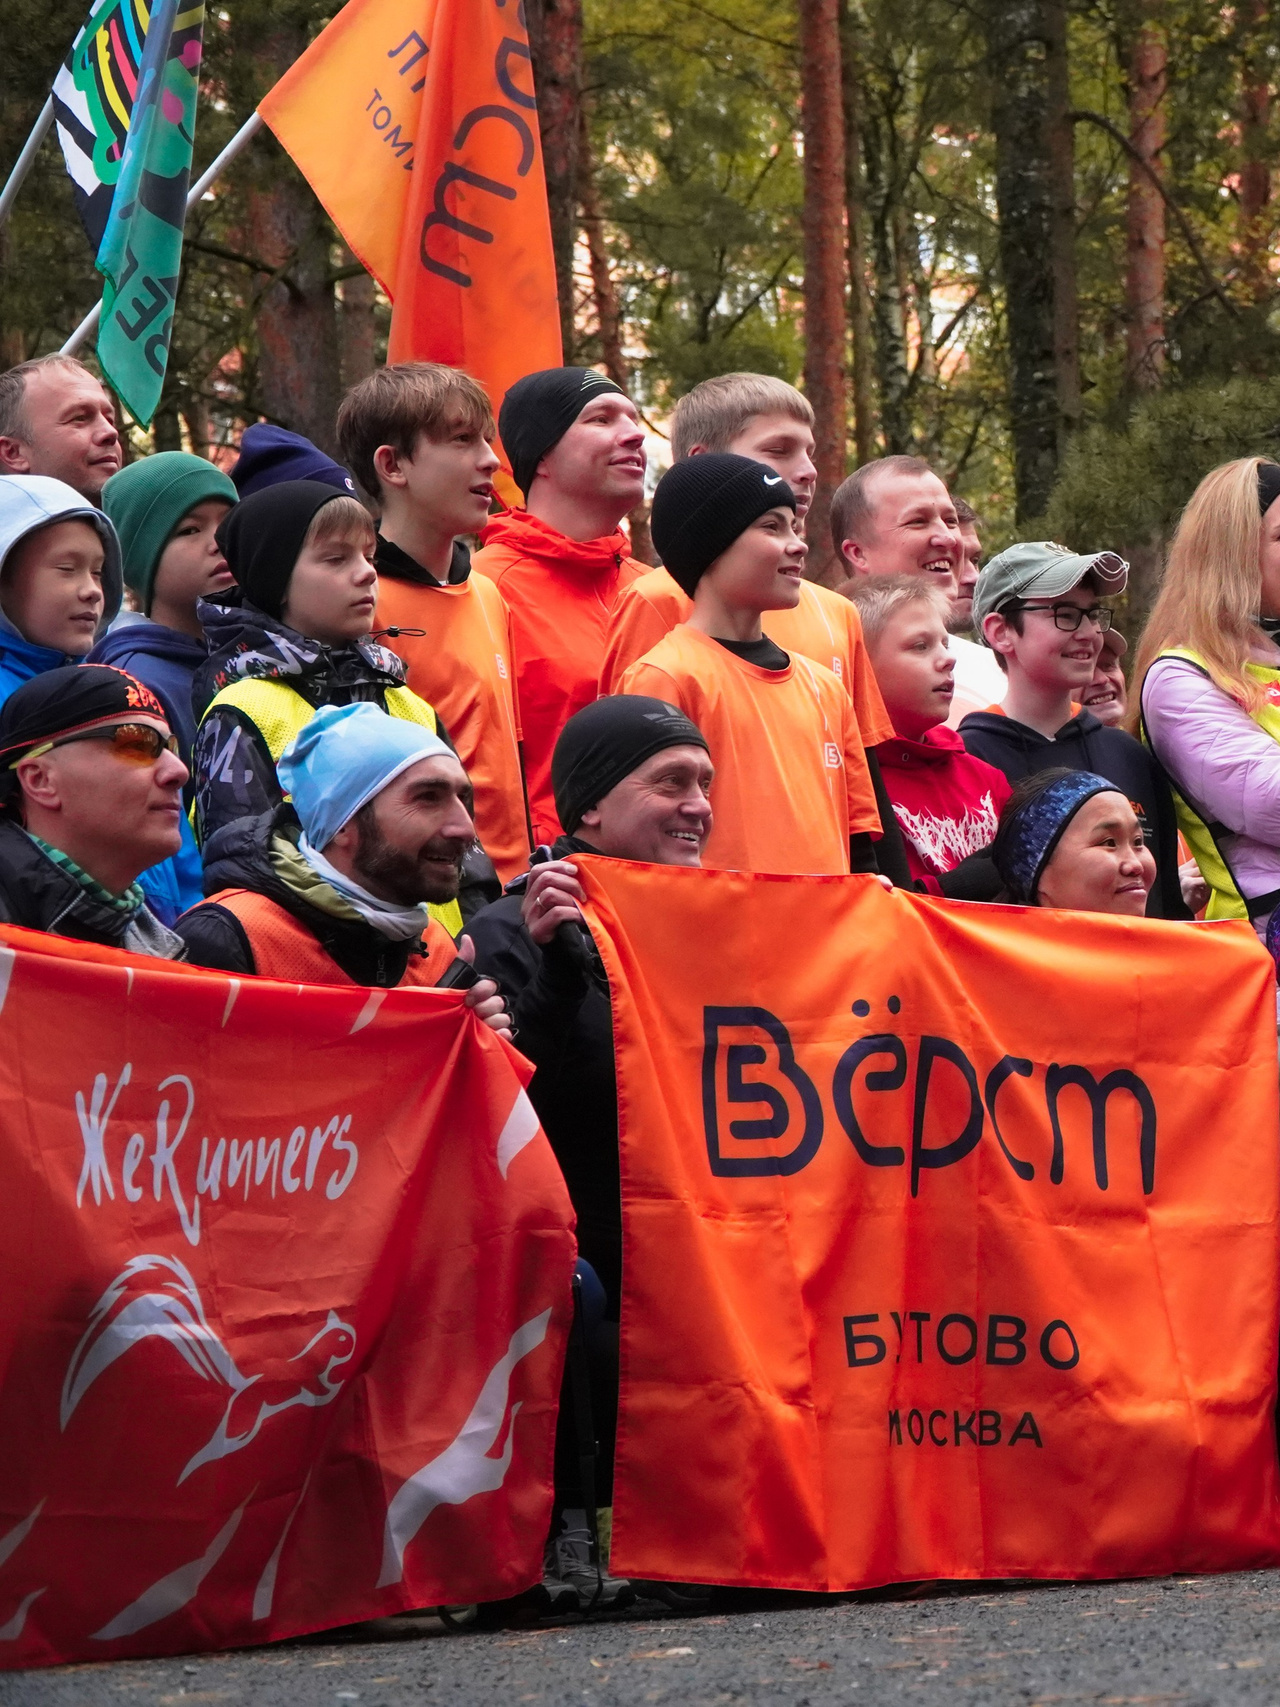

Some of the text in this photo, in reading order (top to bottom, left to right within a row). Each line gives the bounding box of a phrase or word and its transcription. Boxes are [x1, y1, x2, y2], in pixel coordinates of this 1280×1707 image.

[365, 87, 415, 172] ТОМ
[702, 995, 1158, 1199] Вёрст
[843, 1311, 1081, 1371] БУТОВО
[887, 1408, 1044, 1449] МОСКВА
